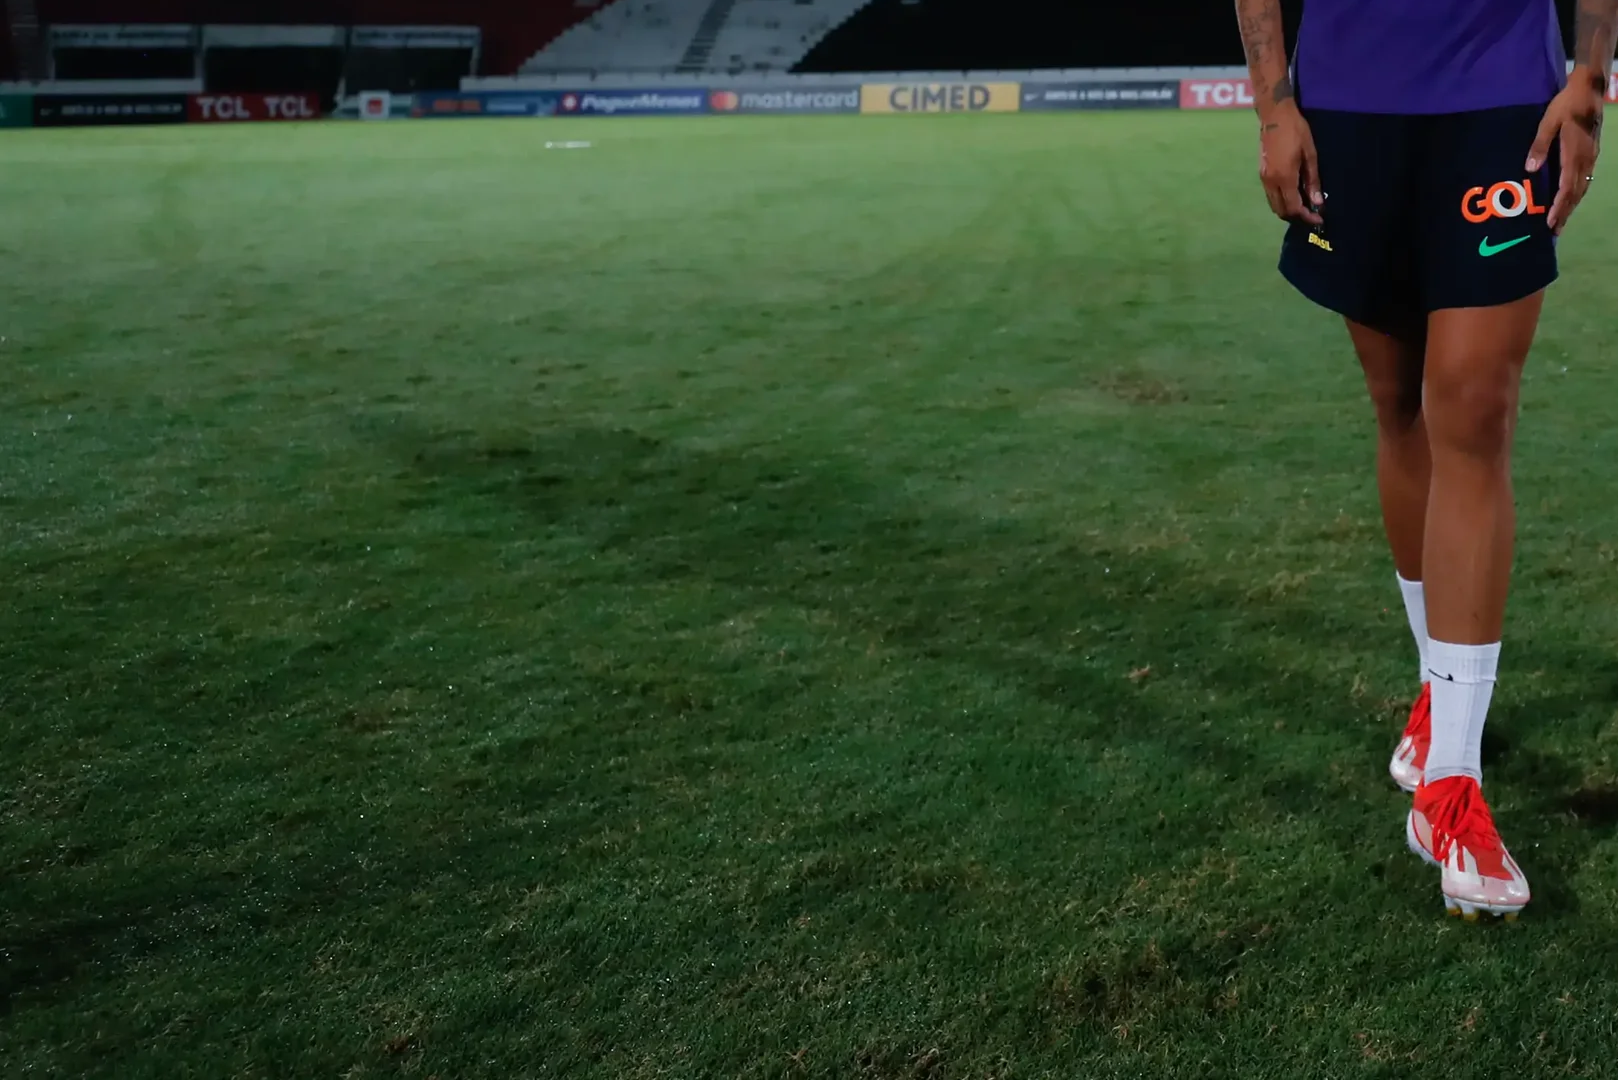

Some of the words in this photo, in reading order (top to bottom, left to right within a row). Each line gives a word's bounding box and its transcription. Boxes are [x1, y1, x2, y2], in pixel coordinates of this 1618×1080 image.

[741, 89, 858, 109] mastercard
[889, 85, 989, 111] CIMED
[1190, 83, 1254, 105] TCL
[196, 96, 250, 118] TCL
[263, 96, 314, 116] TCL
[1461, 179, 1545, 224] GOL
[1308, 232, 1334, 252] BRASIL
